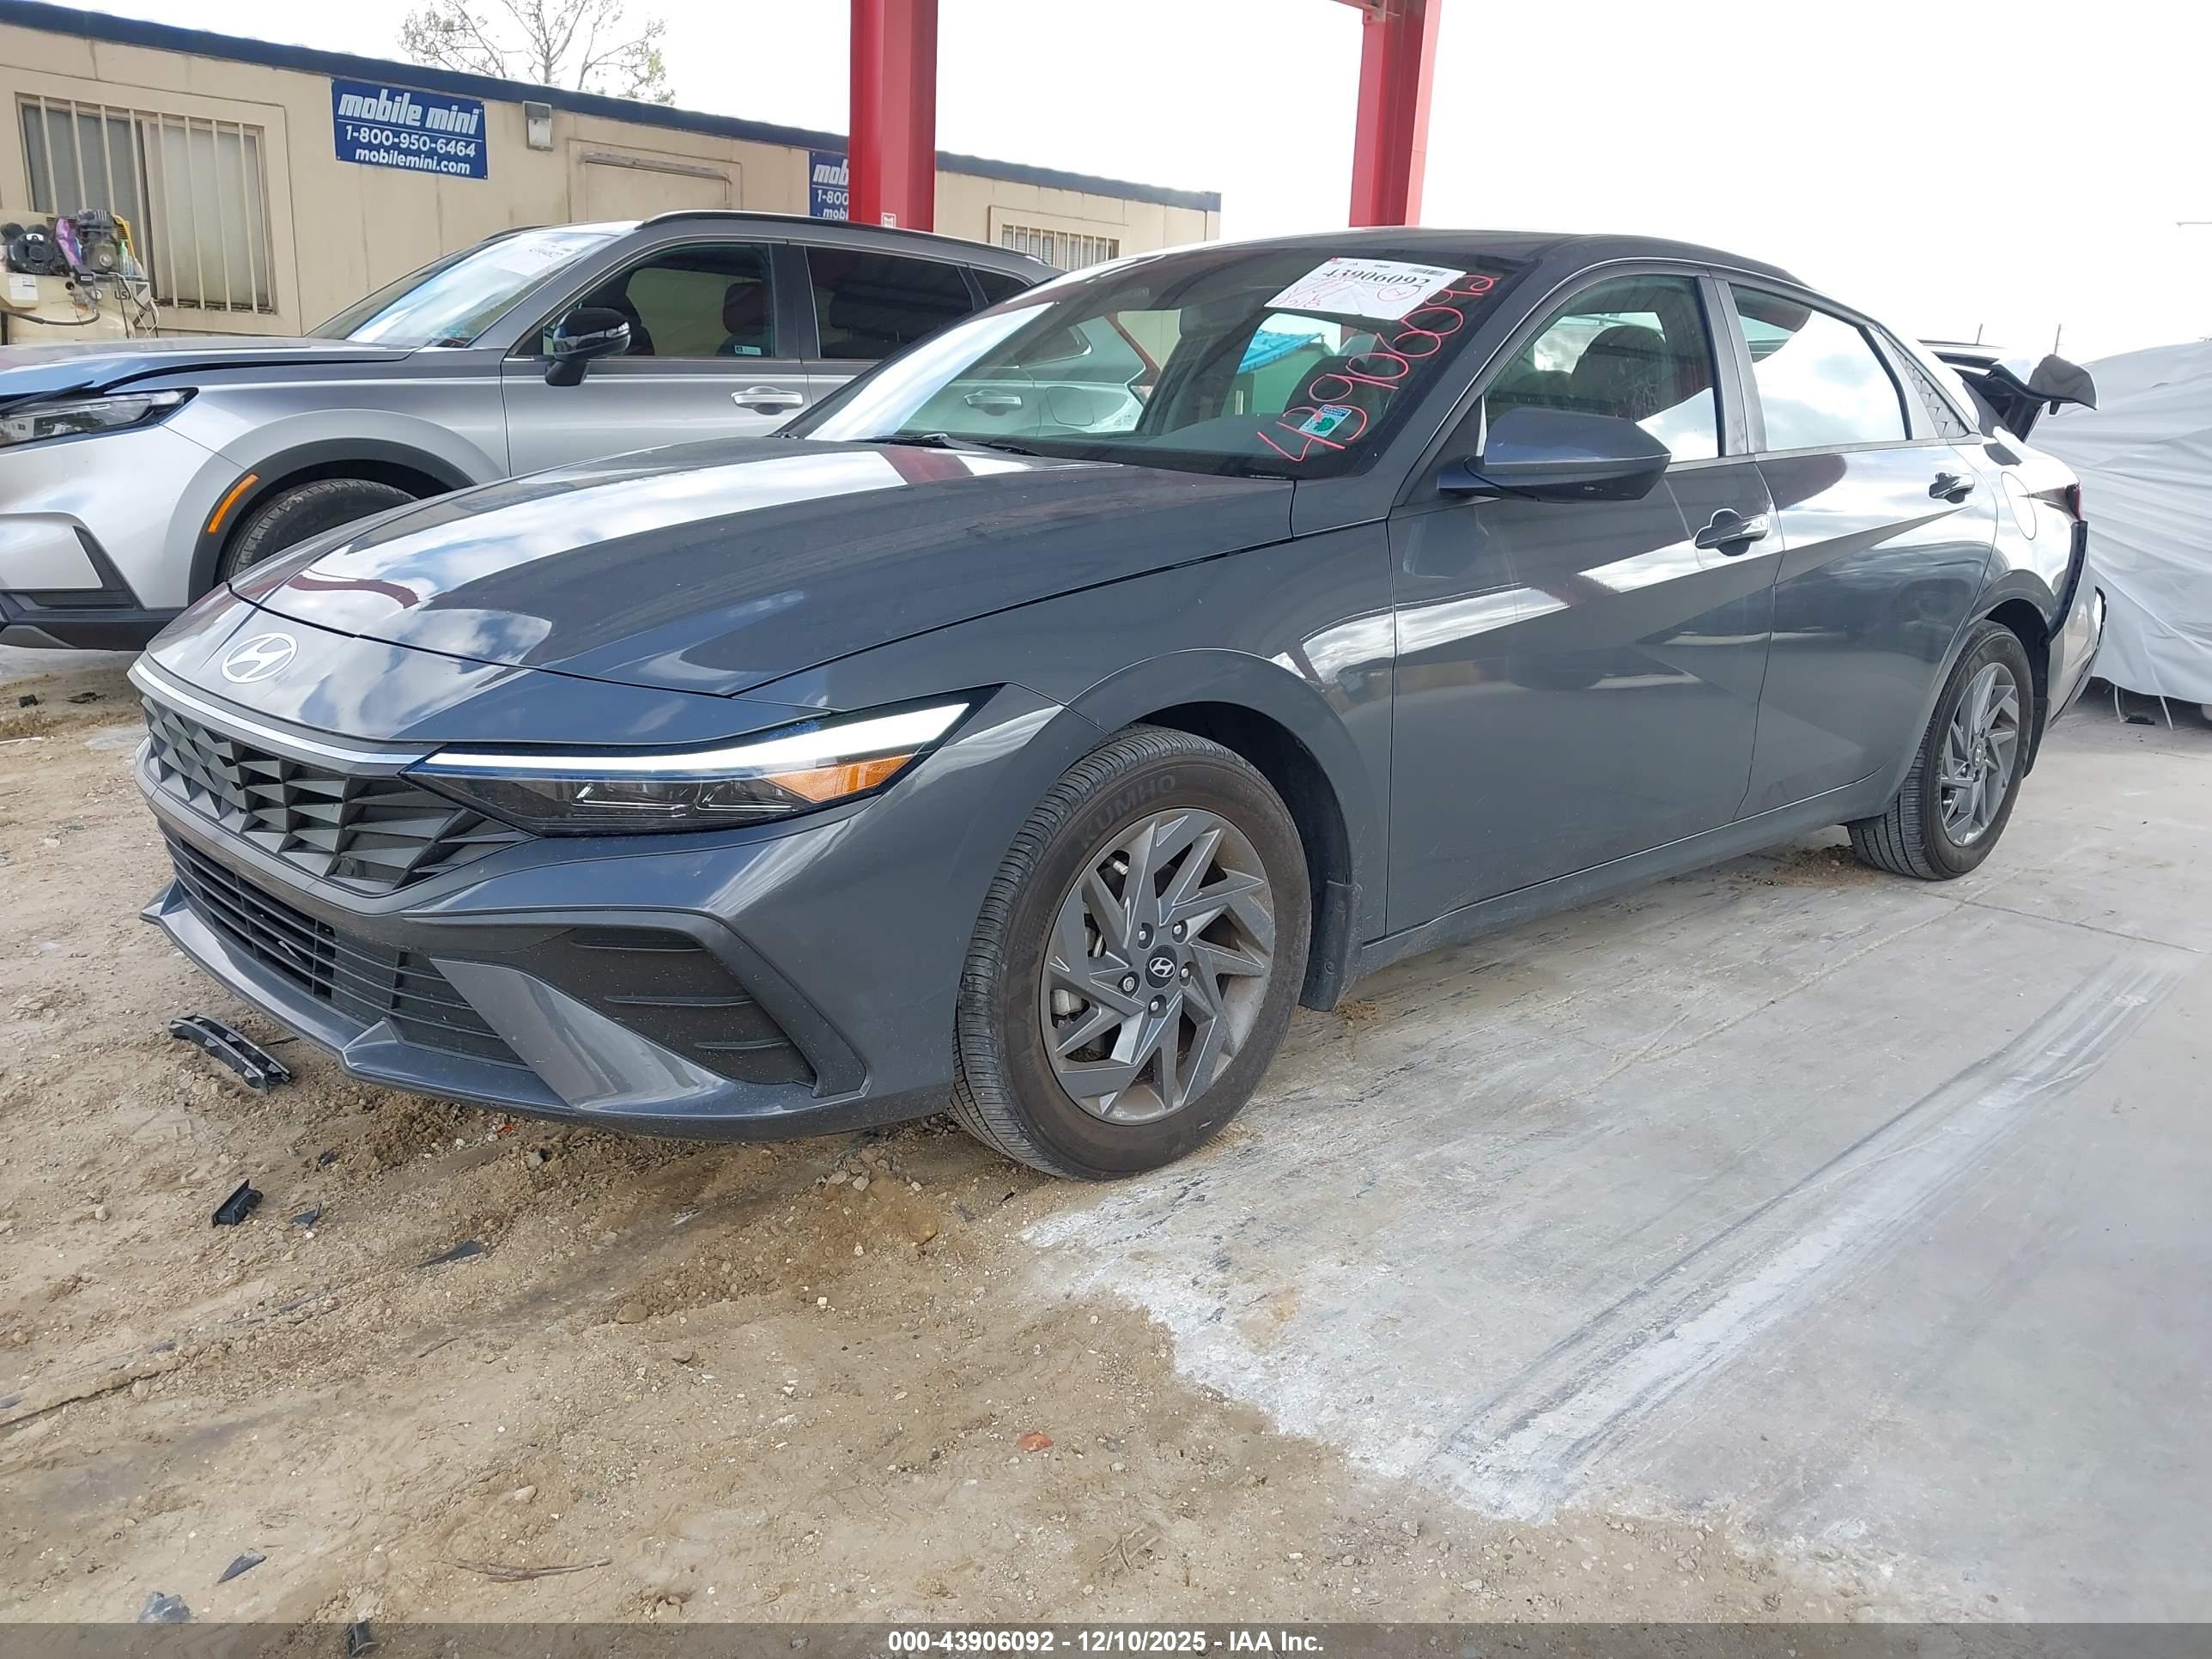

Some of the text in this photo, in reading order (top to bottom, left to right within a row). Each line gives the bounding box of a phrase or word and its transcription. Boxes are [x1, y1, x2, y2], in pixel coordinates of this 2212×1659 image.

[338, 88, 479, 134] mobile mini
[345, 125, 476, 158] 1-800-950-6464
[355, 148, 471, 174] mobilemini.com
